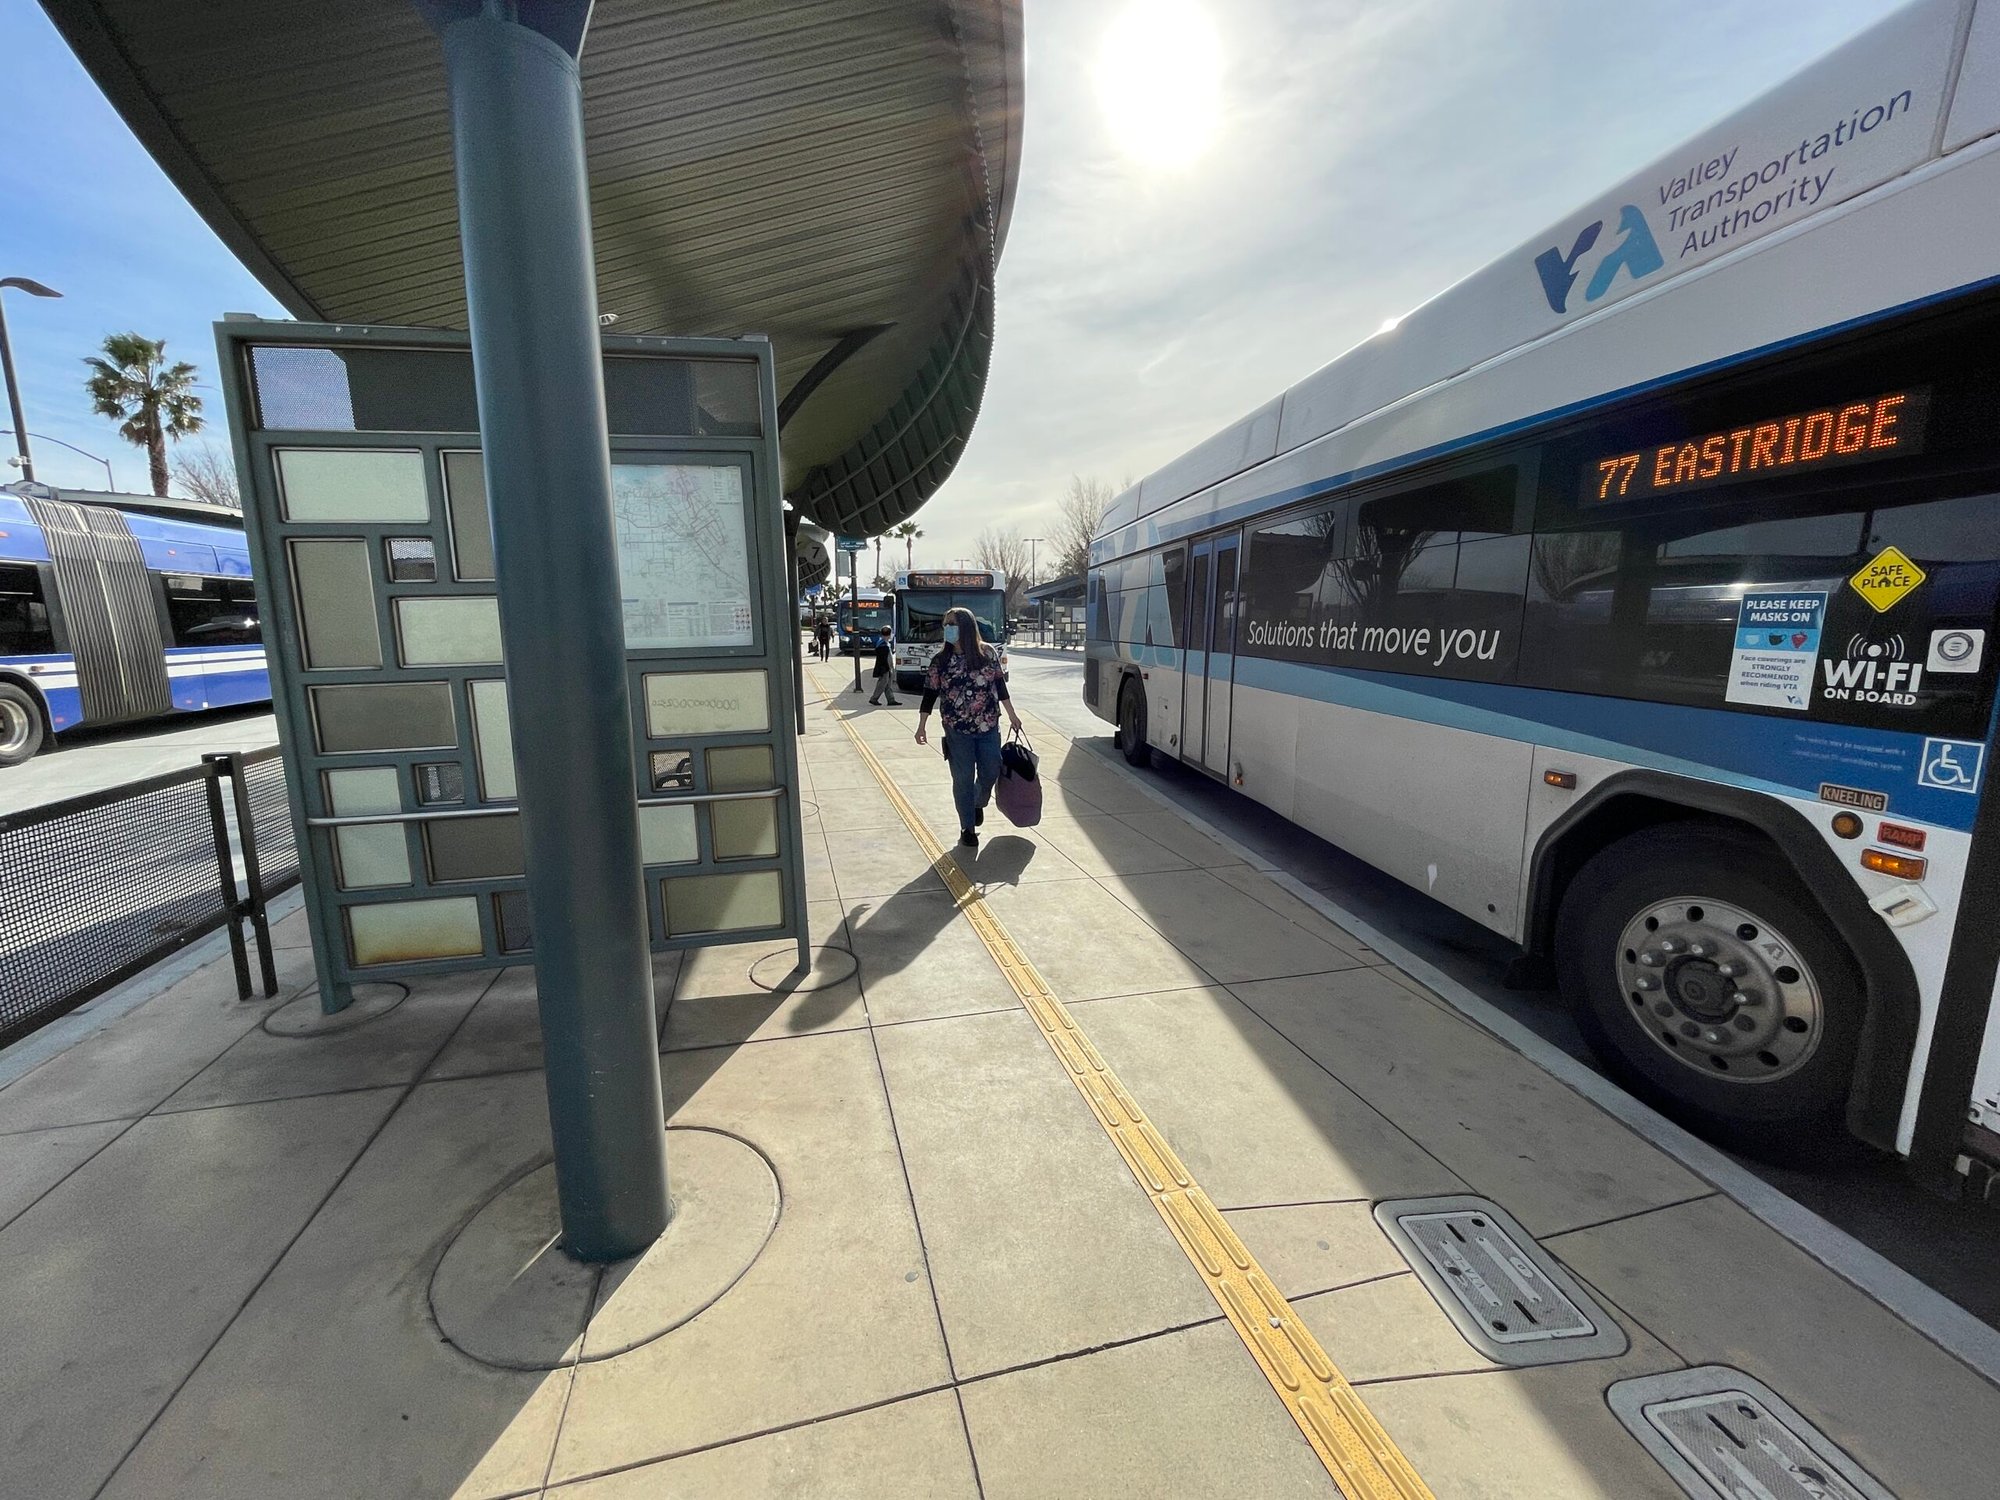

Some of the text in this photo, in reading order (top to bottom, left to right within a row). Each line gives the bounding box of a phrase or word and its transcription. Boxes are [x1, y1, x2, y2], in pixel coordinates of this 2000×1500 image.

[1668, 89, 1912, 232] Transportation
[1659, 147, 1738, 205] Valley
[1680, 168, 1836, 257] Authority
[1599, 395, 1905, 499] 77 EASTRIDGE
[812, 547, 820, 559] 7
[1870, 564, 1904, 577] SAFE
[915, 576, 985, 586] 77 MILPITAS BART
[1746, 599, 1820, 610] PLEASE KEEP
[1750, 612, 1811, 623] MASKS ON
[1247, 618, 1500, 667] Solutions that move you
[1757, 656, 1792, 665] coverings
[1751, 663, 1791, 672] STRONGLY
[1741, 671, 1800, 681] RECOMMENDED
[1760, 681, 1781, 690] riding
[1823, 687, 1917, 706] ON BOARD
[1823, 786, 1884, 810] KNEELING
